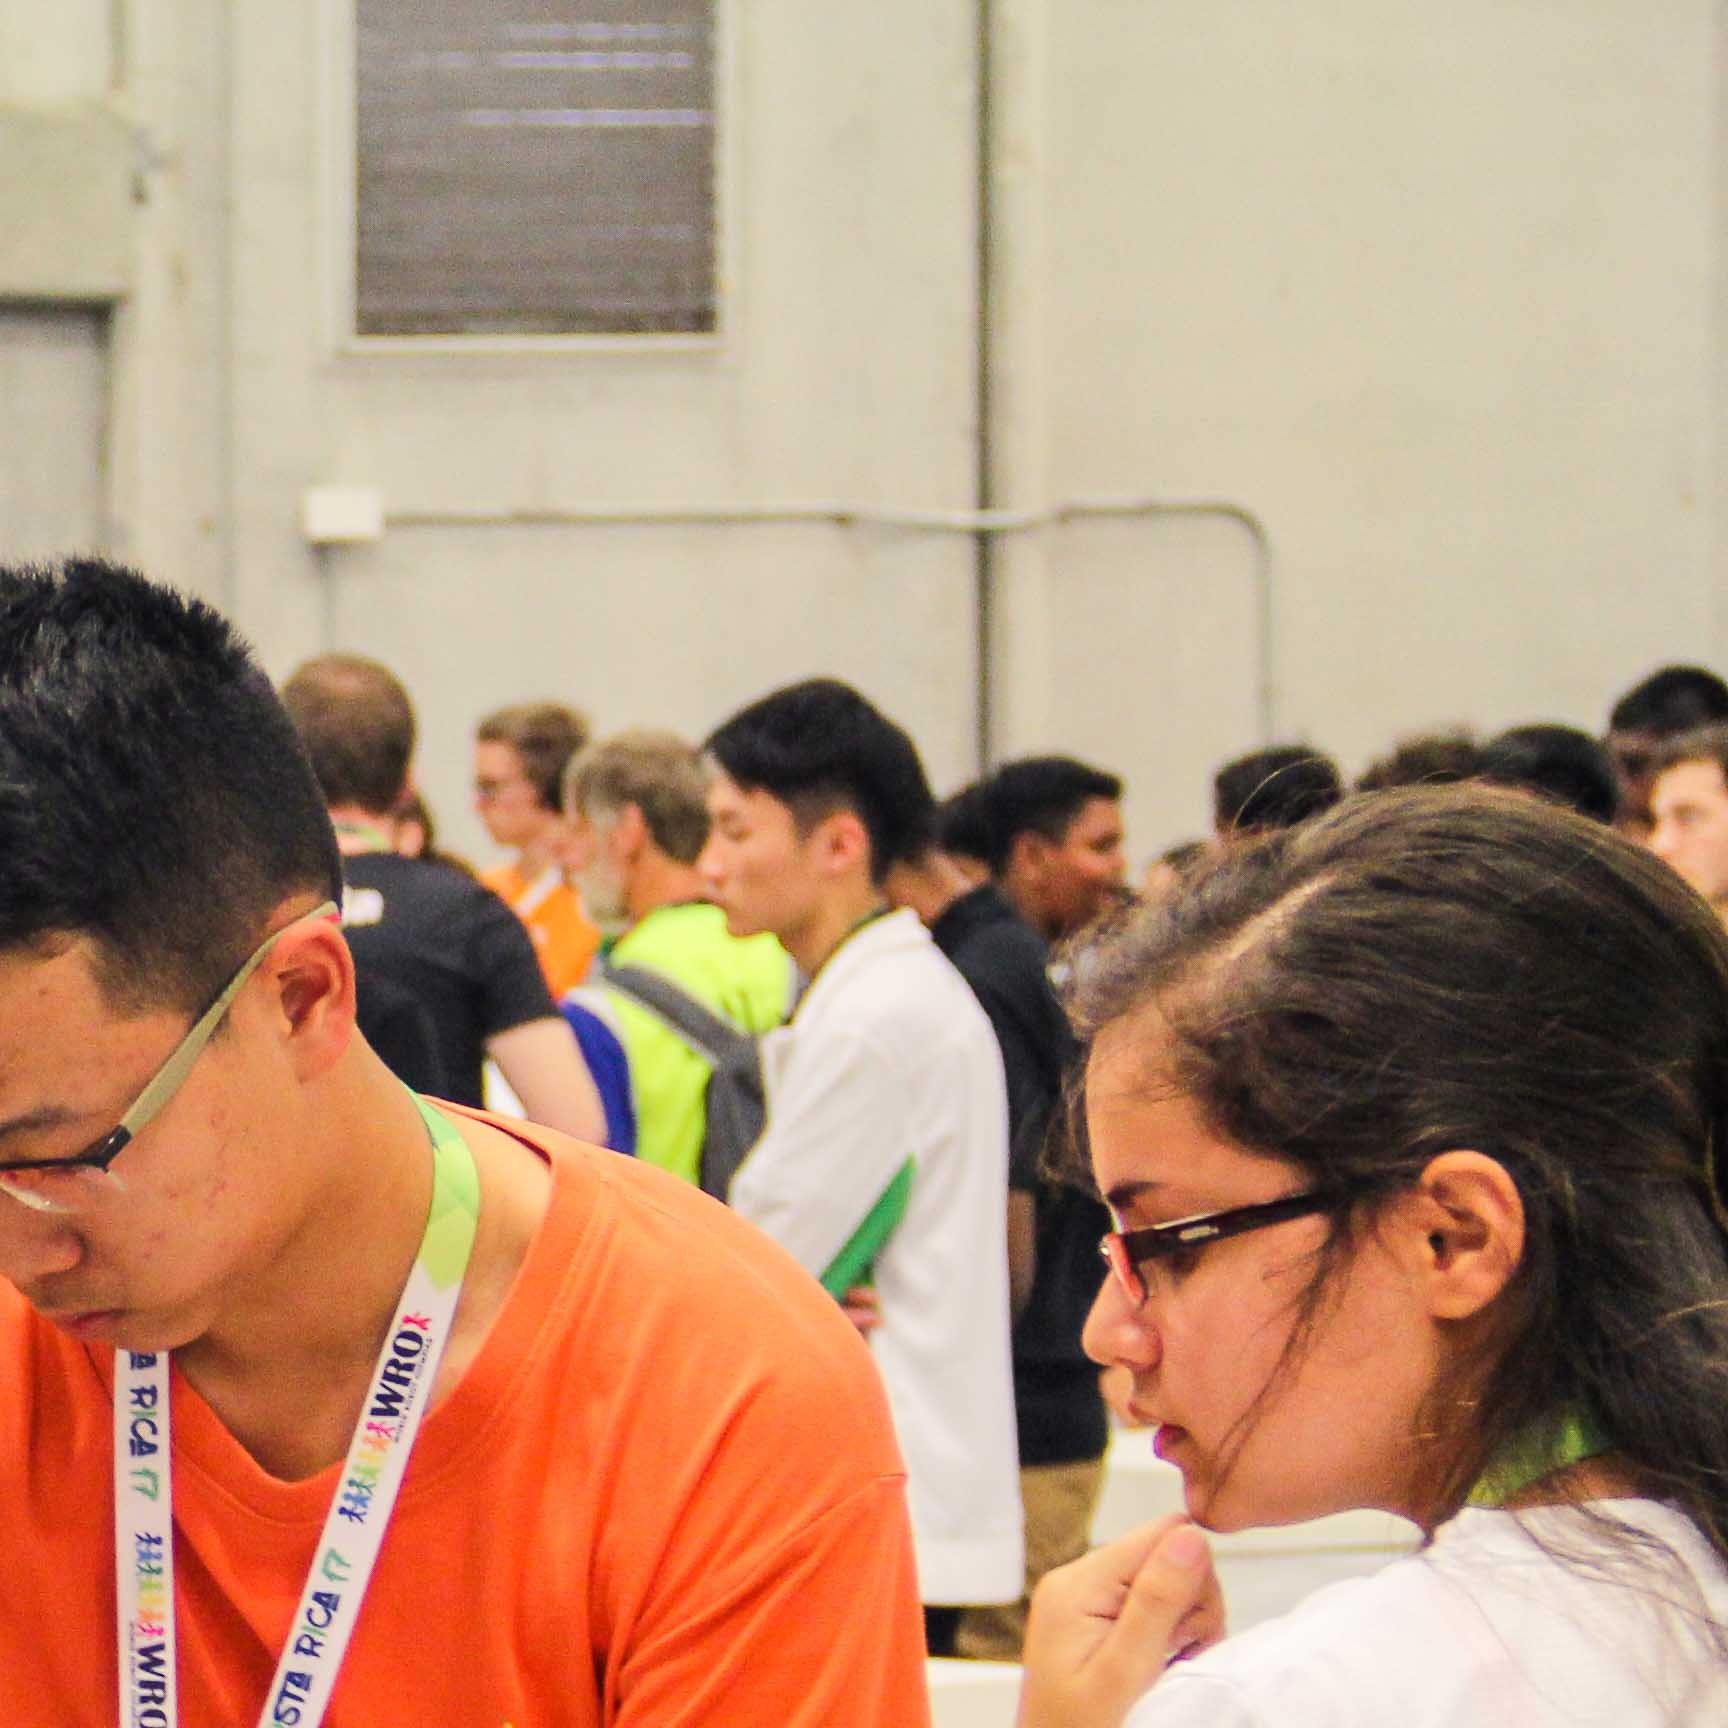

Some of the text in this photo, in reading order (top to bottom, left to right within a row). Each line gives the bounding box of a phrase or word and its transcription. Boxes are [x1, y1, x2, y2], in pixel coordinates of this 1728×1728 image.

[369, 1330, 423, 1416] WRO
[129, 1384, 158, 1457] RICA
[294, 1591, 341, 1658] RICA
